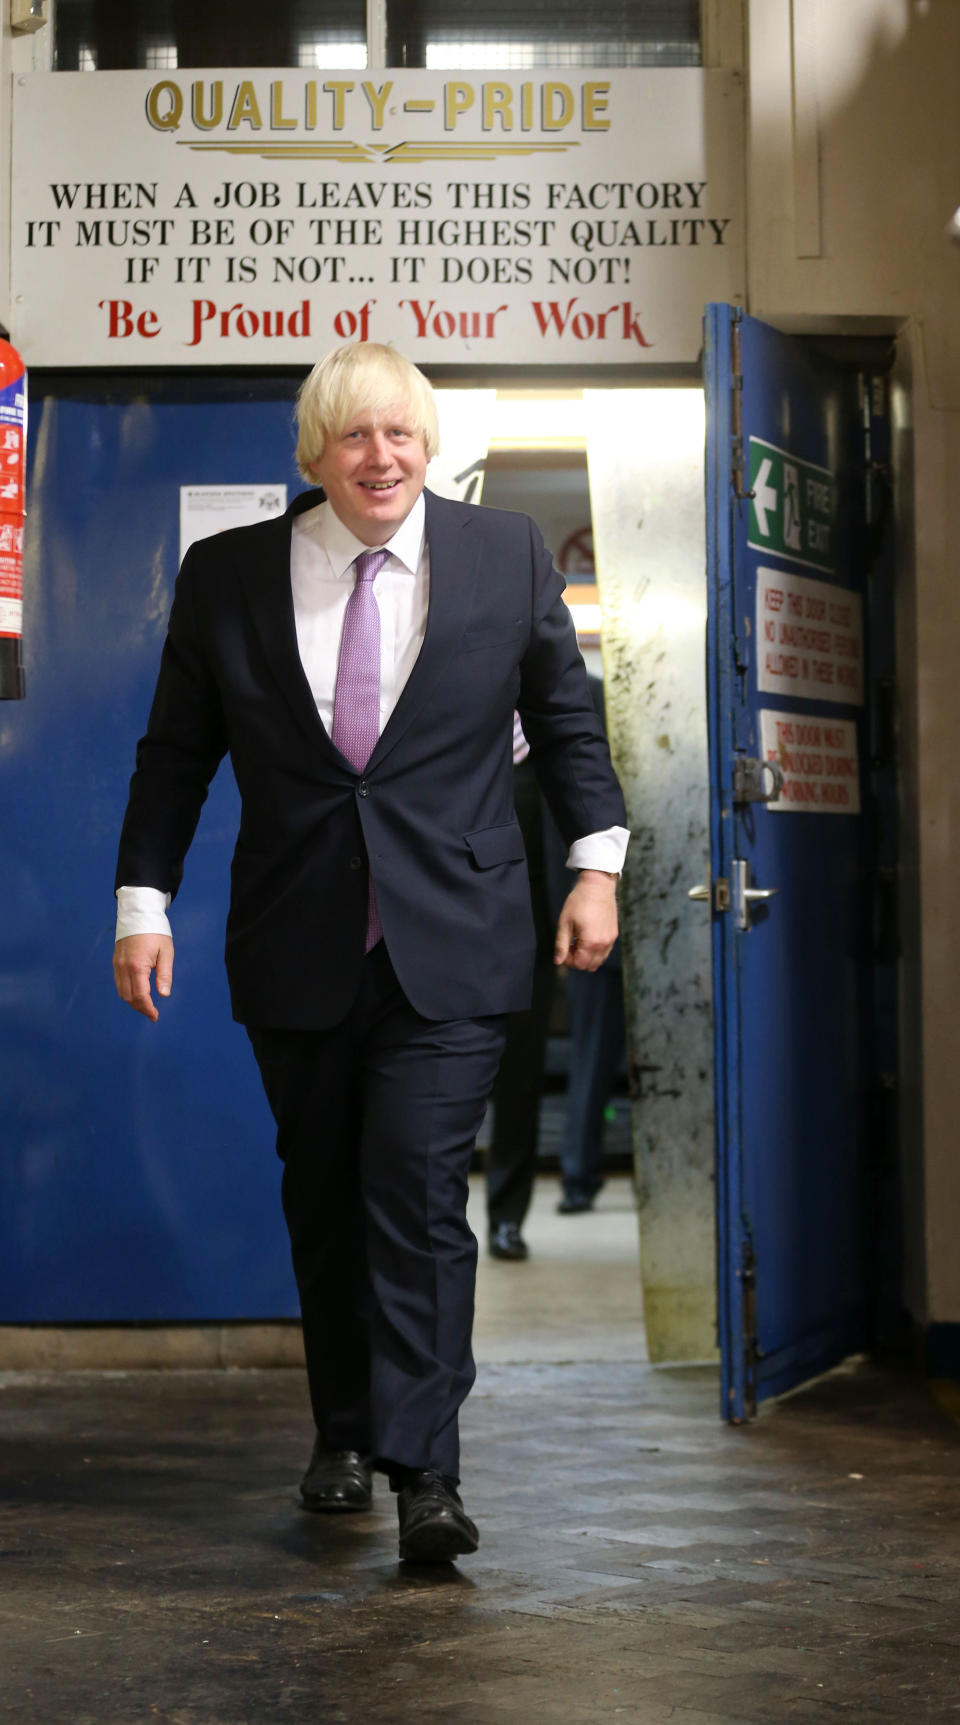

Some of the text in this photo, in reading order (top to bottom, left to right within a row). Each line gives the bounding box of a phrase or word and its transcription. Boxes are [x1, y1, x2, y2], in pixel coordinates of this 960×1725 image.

[49, 182, 709, 210] WHEN A JOB LEAVES THIS FACTORY
[25, 219, 732, 252] IT MUST BE OF THE HIGHEST QUALITY
[125, 257, 631, 284] IF IT IS NOT... IT DOES NOT!
[97, 298, 653, 348] Be Proud of Your Work
[765, 589, 784, 612] KEEP
[765, 620, 776, 643] NO
